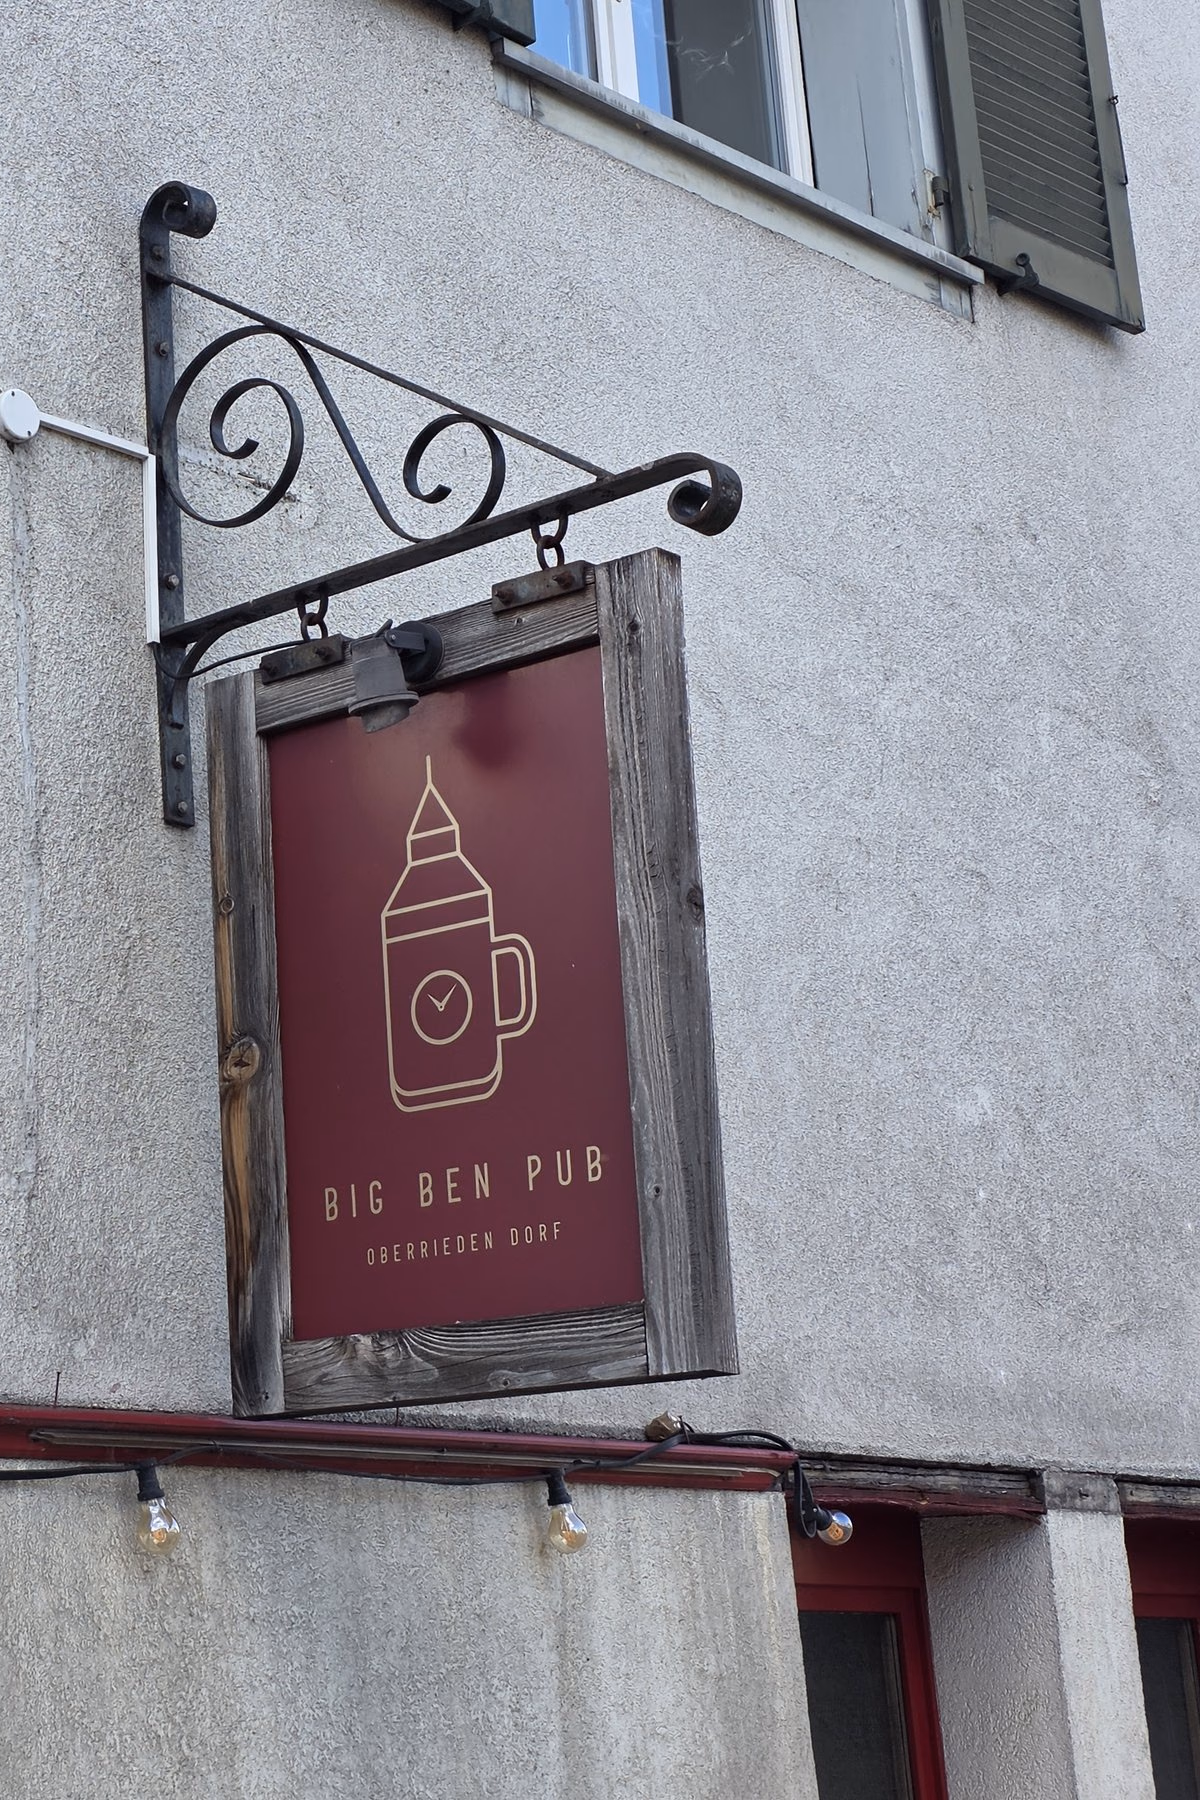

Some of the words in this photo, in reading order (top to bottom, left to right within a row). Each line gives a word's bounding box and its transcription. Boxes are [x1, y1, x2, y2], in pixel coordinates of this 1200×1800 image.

[325, 1180, 383, 1222] BIG
[419, 1162, 490, 1208] BEN
[526, 1145, 602, 1191] PUB
[367, 1231, 493, 1265] OBERRIEDEN
[510, 1221, 561, 1246] DORF
